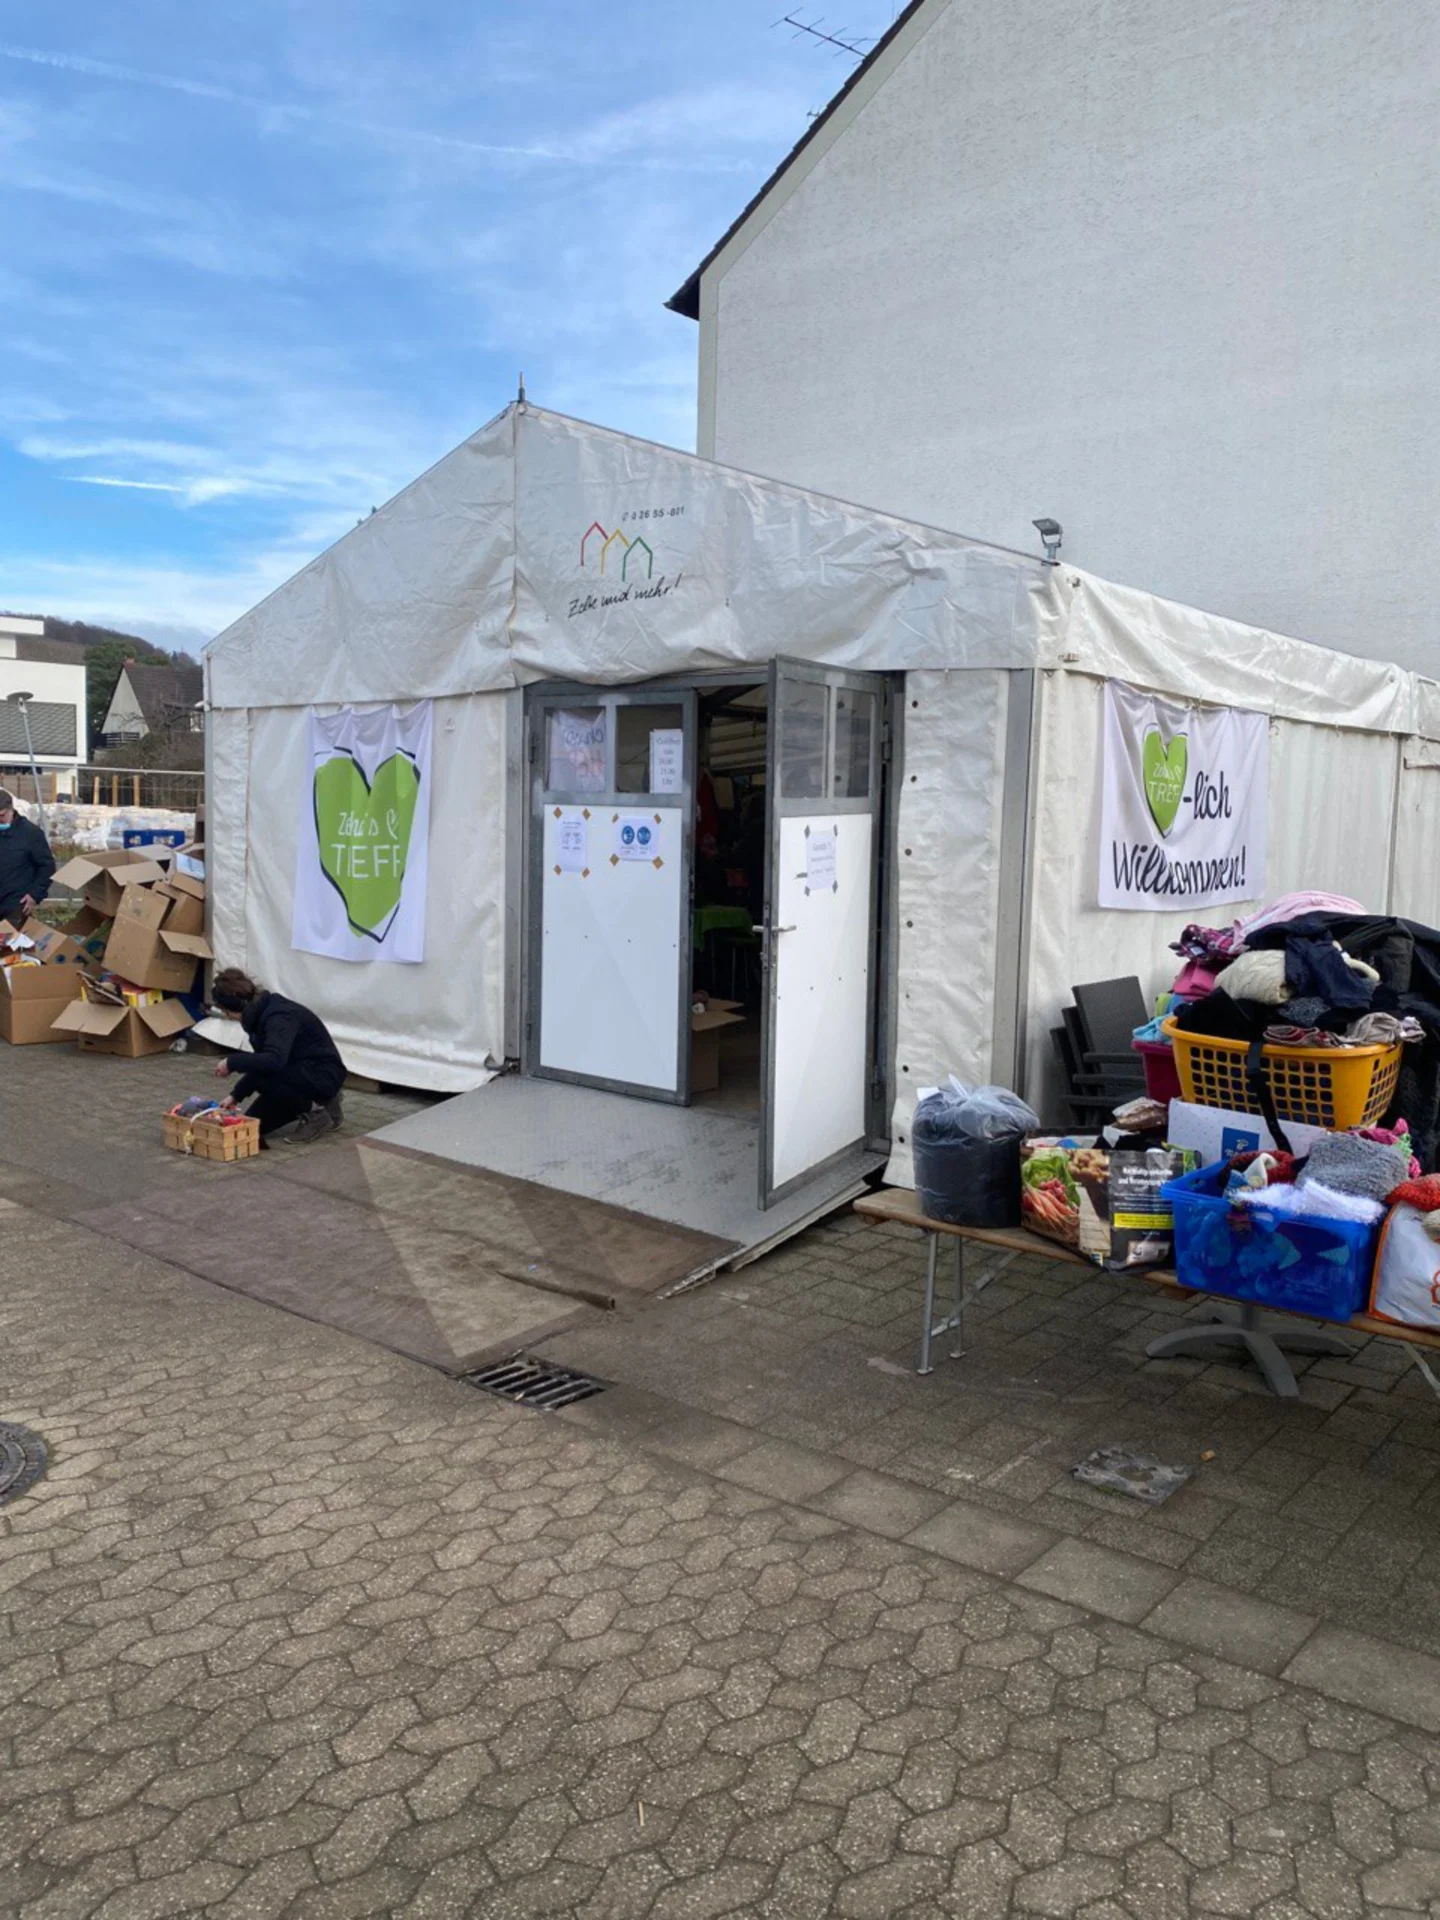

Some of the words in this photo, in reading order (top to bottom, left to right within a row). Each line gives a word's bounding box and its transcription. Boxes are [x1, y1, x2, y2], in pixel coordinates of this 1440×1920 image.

[601, 583, 633, 607] und
[634, 573, 682, 599] mehr!
[330, 843, 401, 878] TEFF
